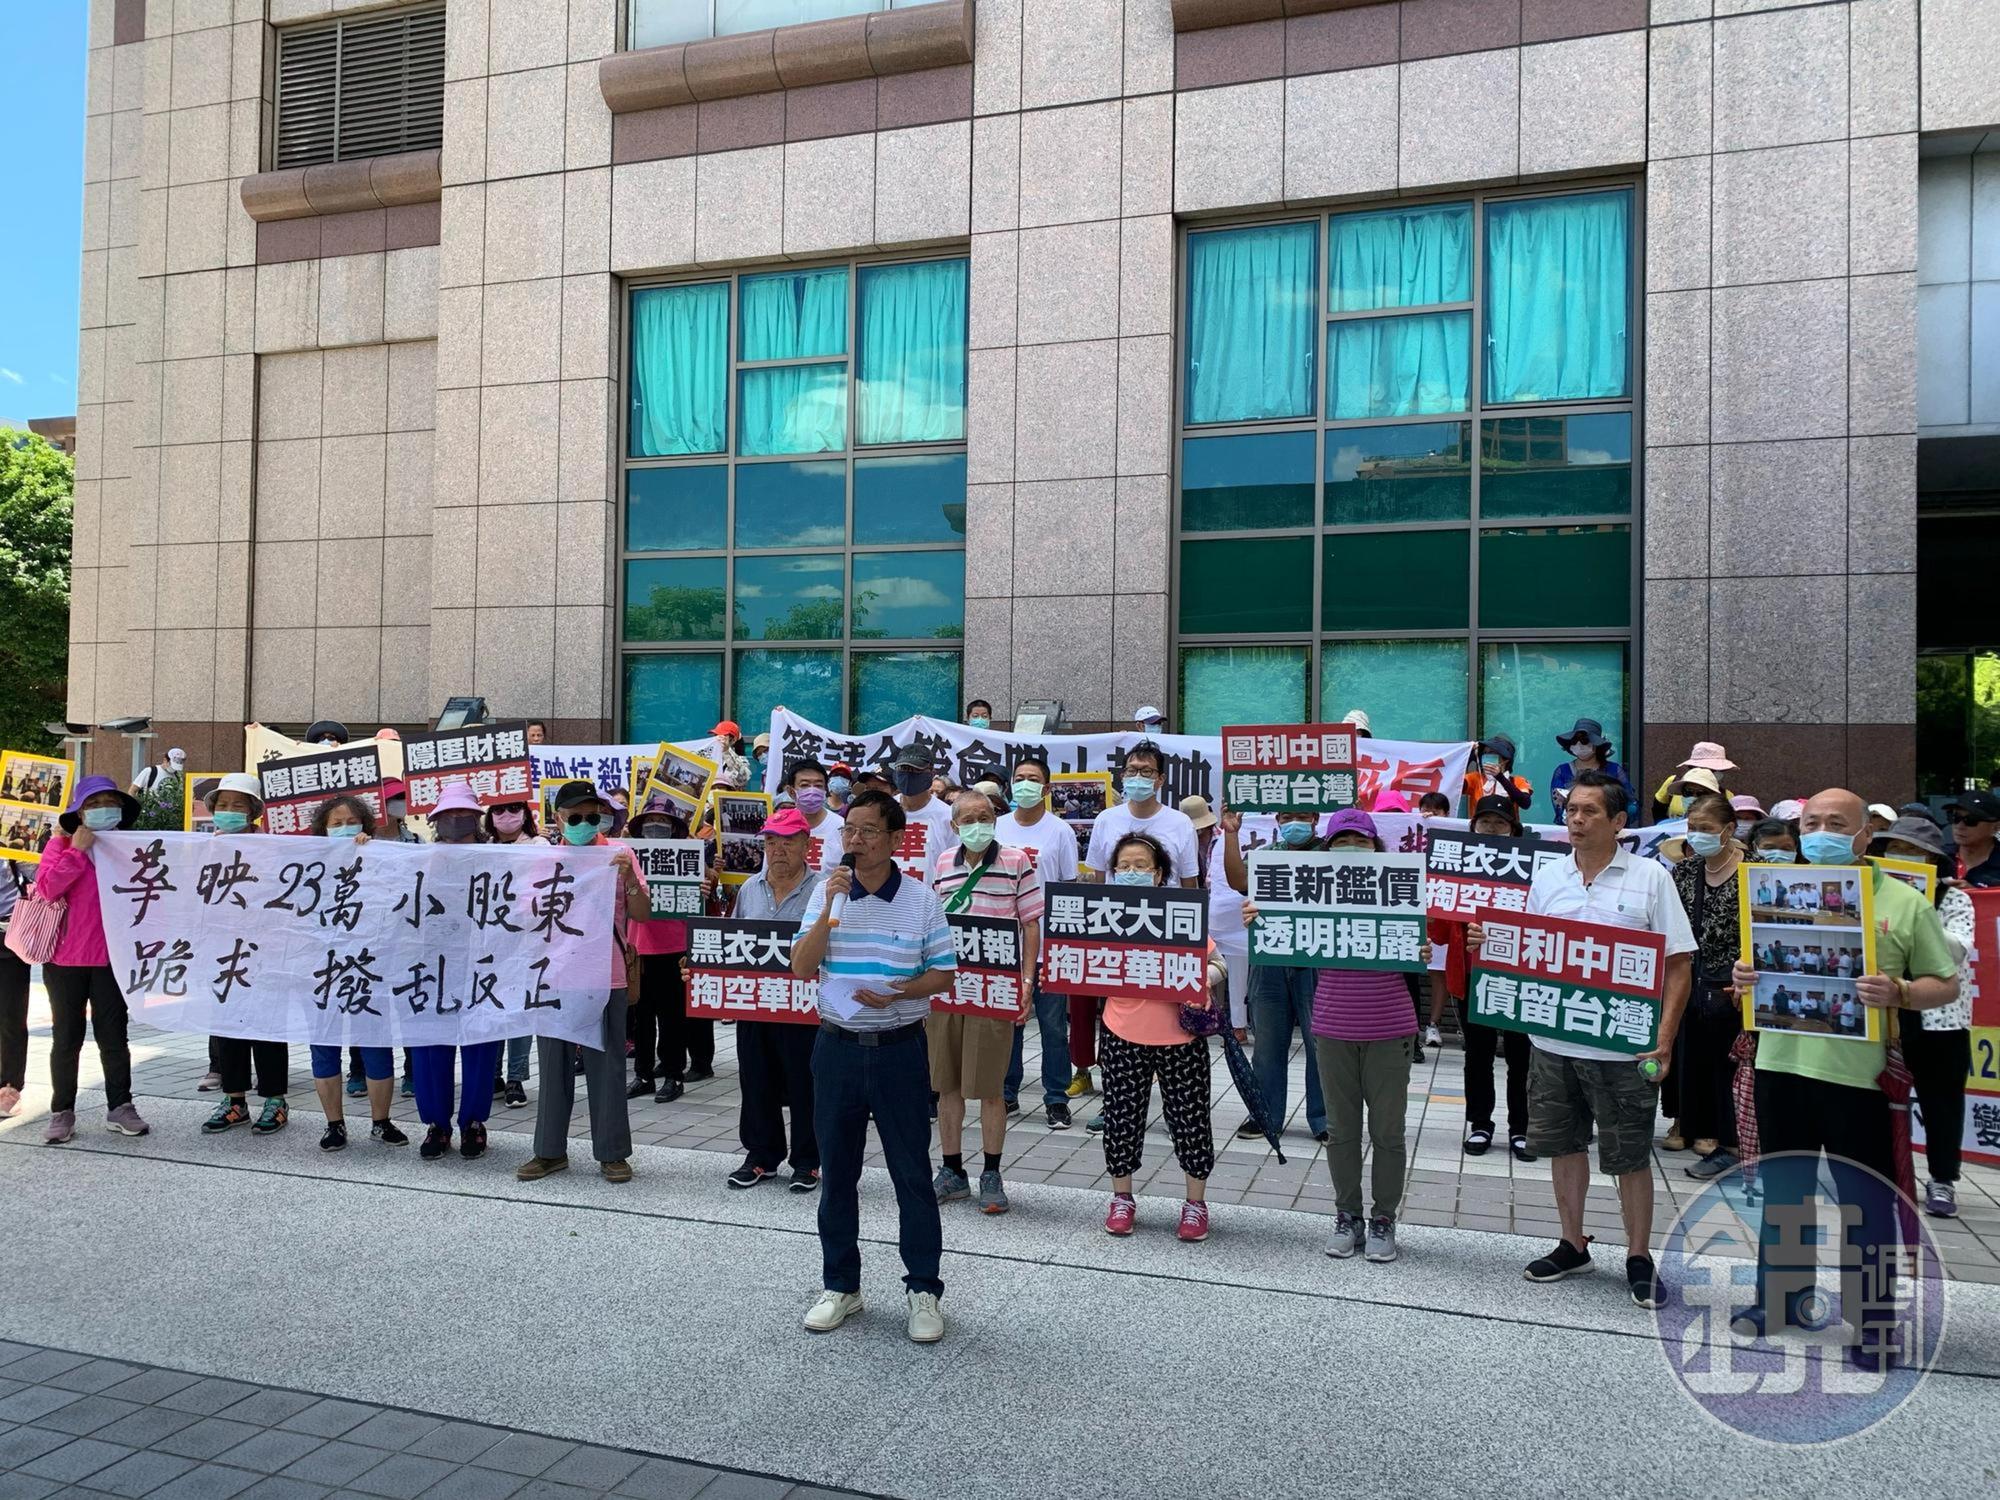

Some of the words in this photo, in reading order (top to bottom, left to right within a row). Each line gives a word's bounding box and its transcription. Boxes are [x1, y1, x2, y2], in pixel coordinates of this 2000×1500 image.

[407, 730, 525, 771] 隱匿財報
[1227, 733, 1352, 766] 圖利中國
[262, 755, 378, 799] 隱匿財報
[1227, 773, 1354, 806] 債留台灣
[1254, 864, 1421, 908] 重新鑑價
[1049, 895, 1202, 941] 黑衣大同
[1254, 915, 1421, 962] 透明揭露
[691, 929, 796, 967] 黑衣大
[1048, 944, 1202, 992] 掏空華映
[1481, 920, 1657, 990] 圖利中國
[691, 973, 821, 1017] 掏空華映
[930, 971, 1020, 1011] 資產
[1475, 973, 1654, 1046] 債留台灣
